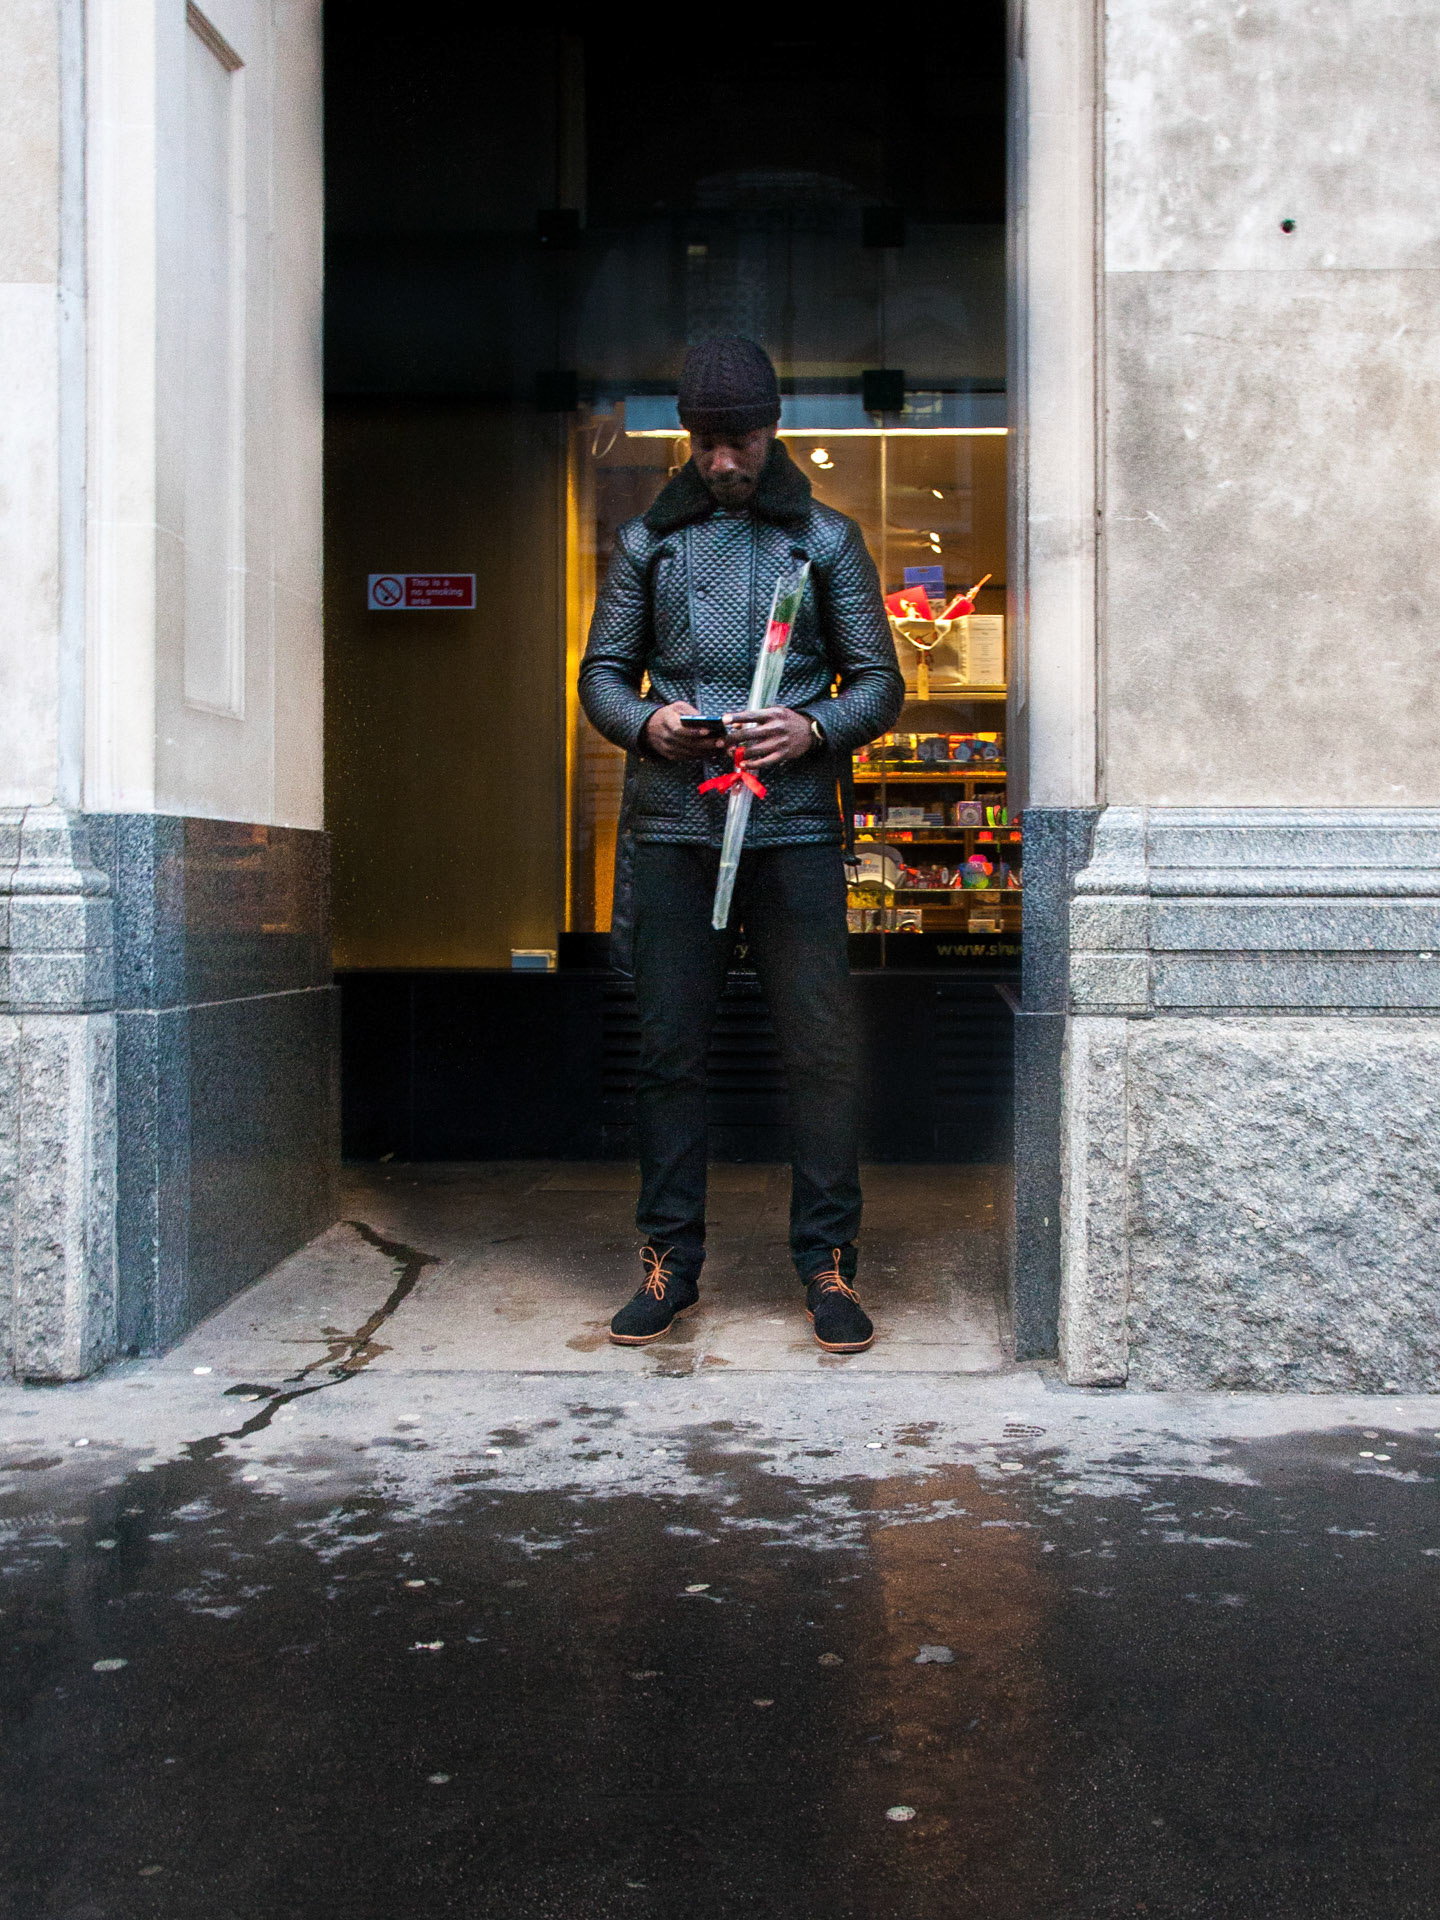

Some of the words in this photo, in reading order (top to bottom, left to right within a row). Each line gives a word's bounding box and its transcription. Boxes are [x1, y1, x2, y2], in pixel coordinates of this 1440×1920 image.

[411, 579, 430, 587] This
[432, 578, 440, 586] is
[425, 588, 464, 598] smoking
